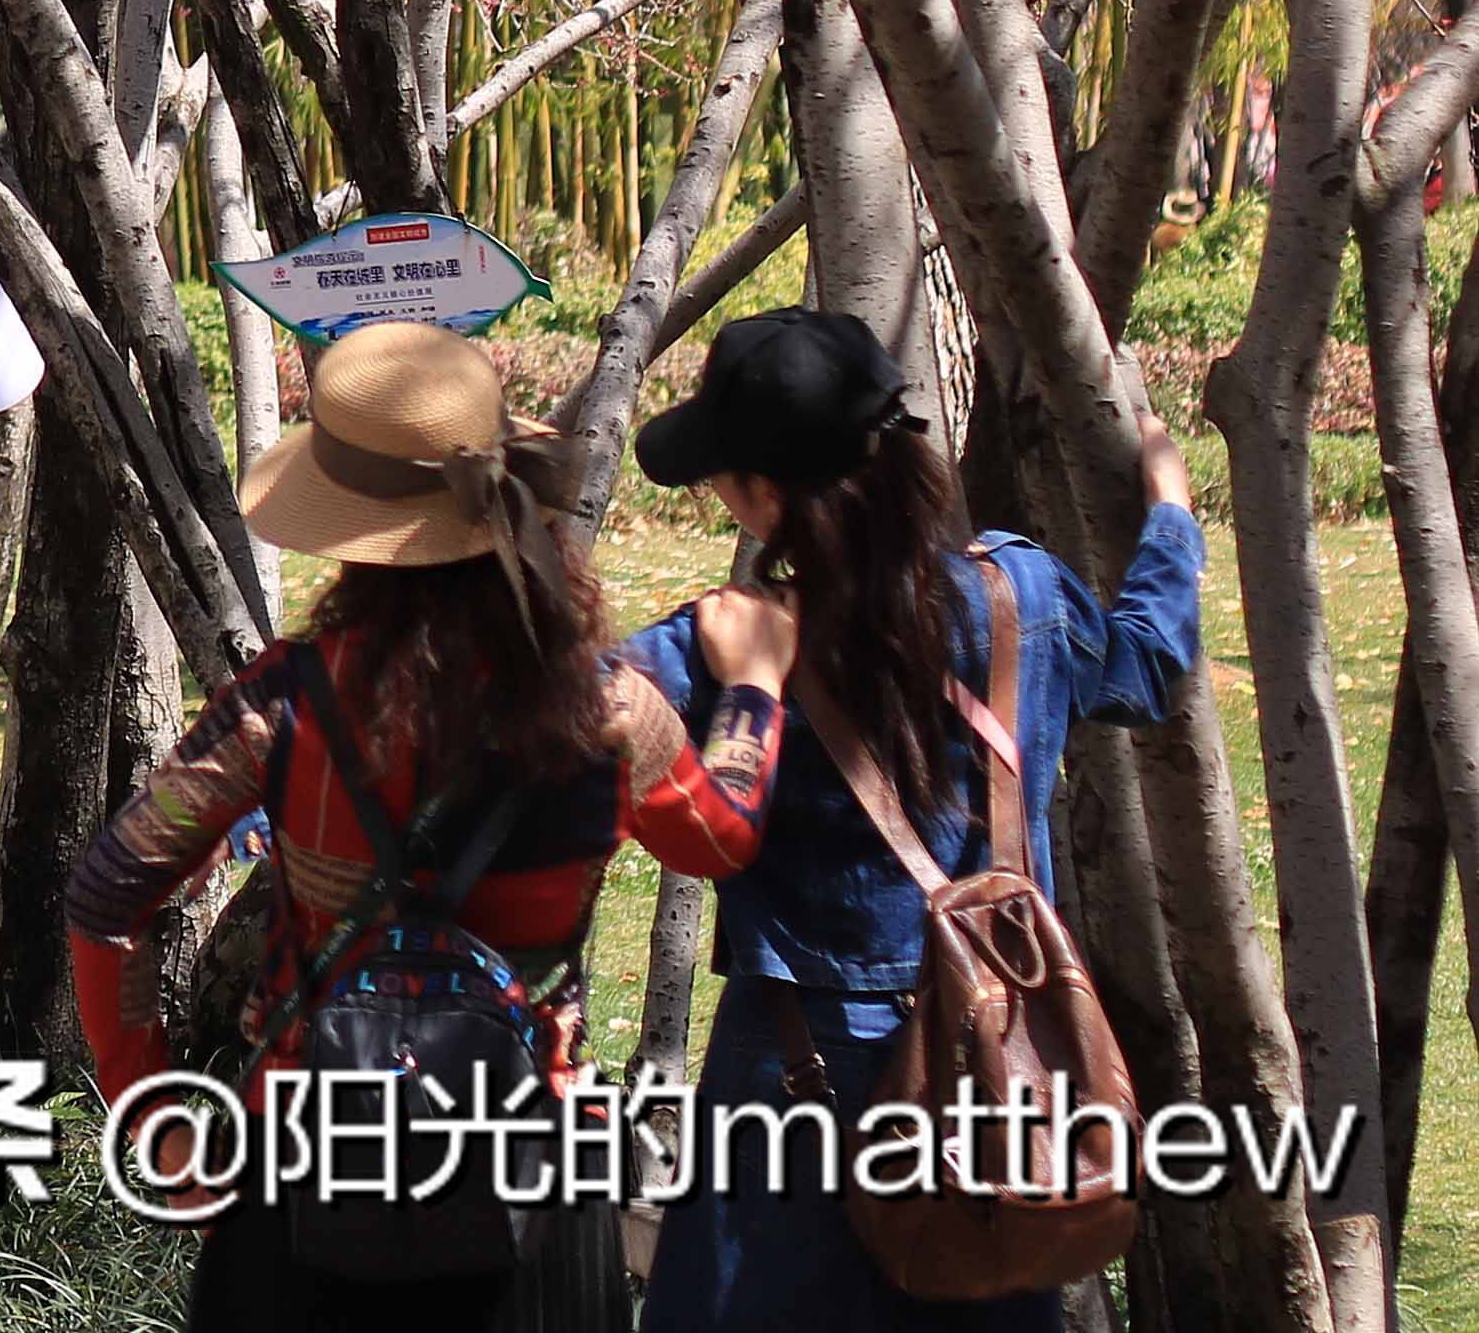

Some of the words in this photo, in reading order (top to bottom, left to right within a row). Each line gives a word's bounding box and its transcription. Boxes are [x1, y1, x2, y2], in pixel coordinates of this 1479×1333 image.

[392, 258, 462, 282] 文明在心里
